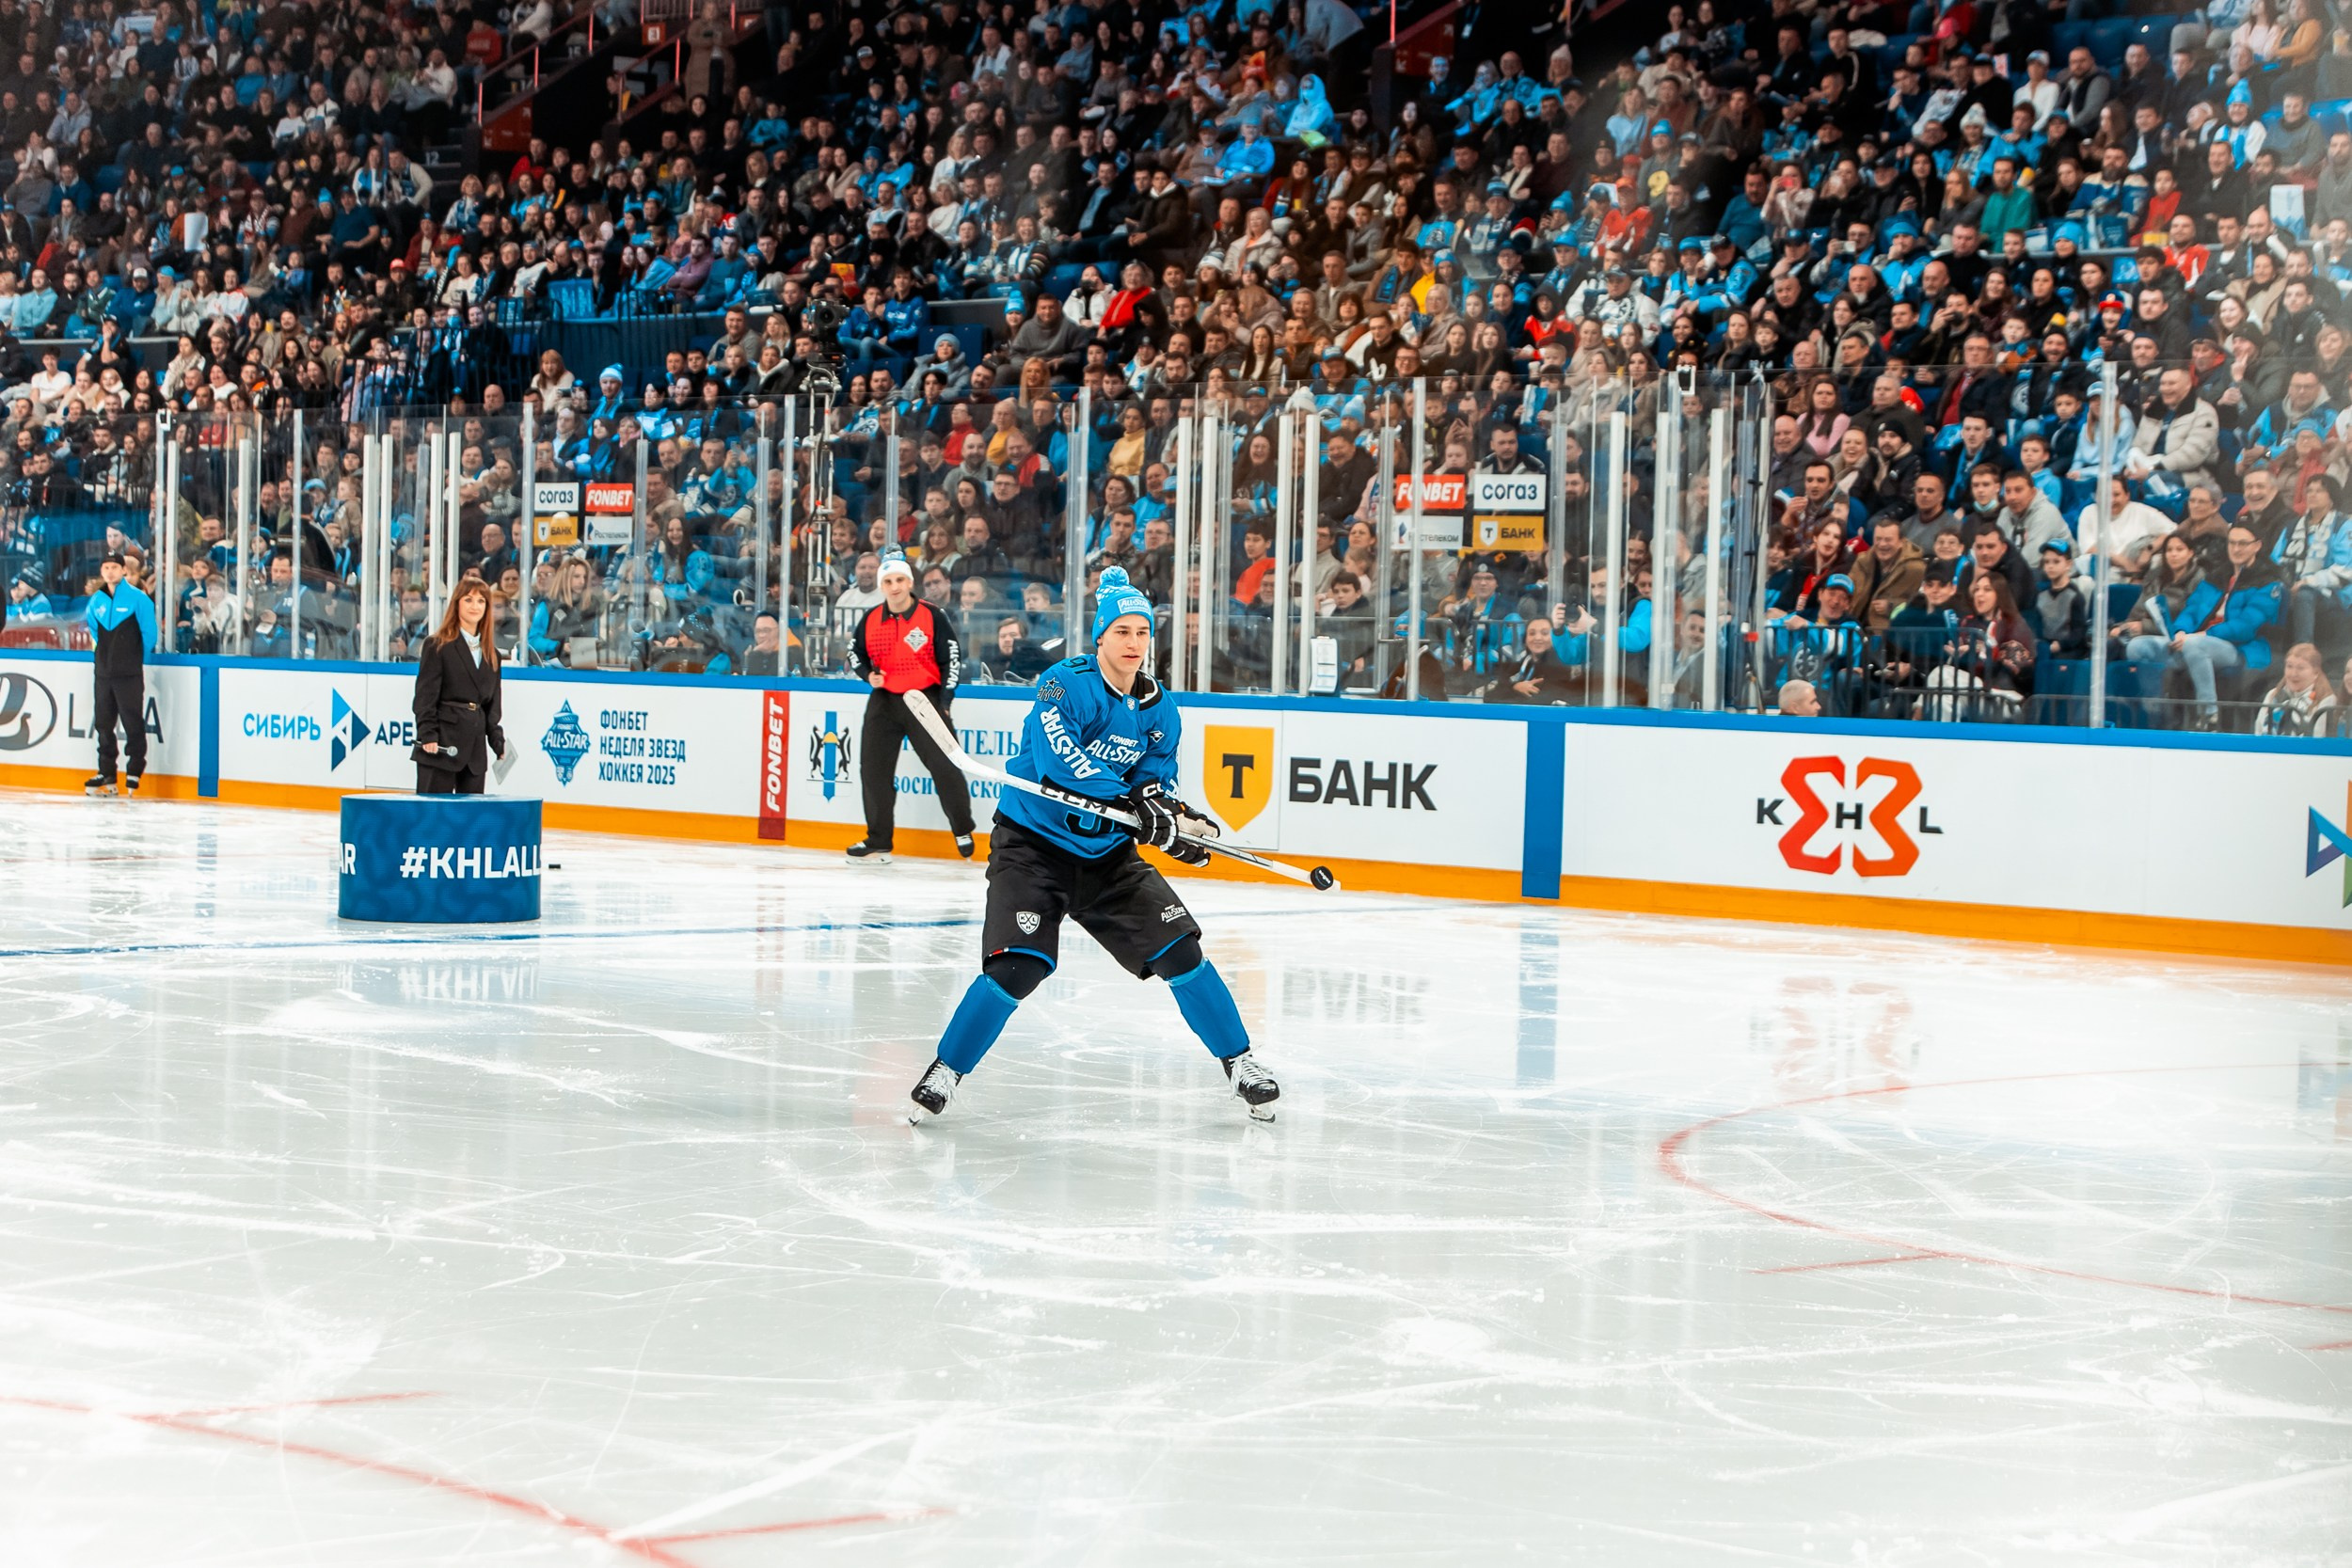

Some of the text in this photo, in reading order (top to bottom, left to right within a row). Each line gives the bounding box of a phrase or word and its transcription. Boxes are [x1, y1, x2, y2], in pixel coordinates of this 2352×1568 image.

[586, 489, 633, 506] FONBET
[550, 527, 572, 535] БАНК
[1501, 527, 1535, 539] БАНК
[68, 691, 165, 744] LA
[243, 712, 321, 741] СИБИРЬ
[600, 708, 648, 731] ФОНБЕТ
[599, 736, 686, 763] НЕДЕЛЯ ЗВЕЗД
[1107, 734, 1139, 748] FONBET
[766, 697, 784, 813] FONBET
[598, 762, 675, 785] ХОККЕЯ 2025
[1289, 756, 1438, 811] БАНК
[1041, 785, 1107, 815] CCM
